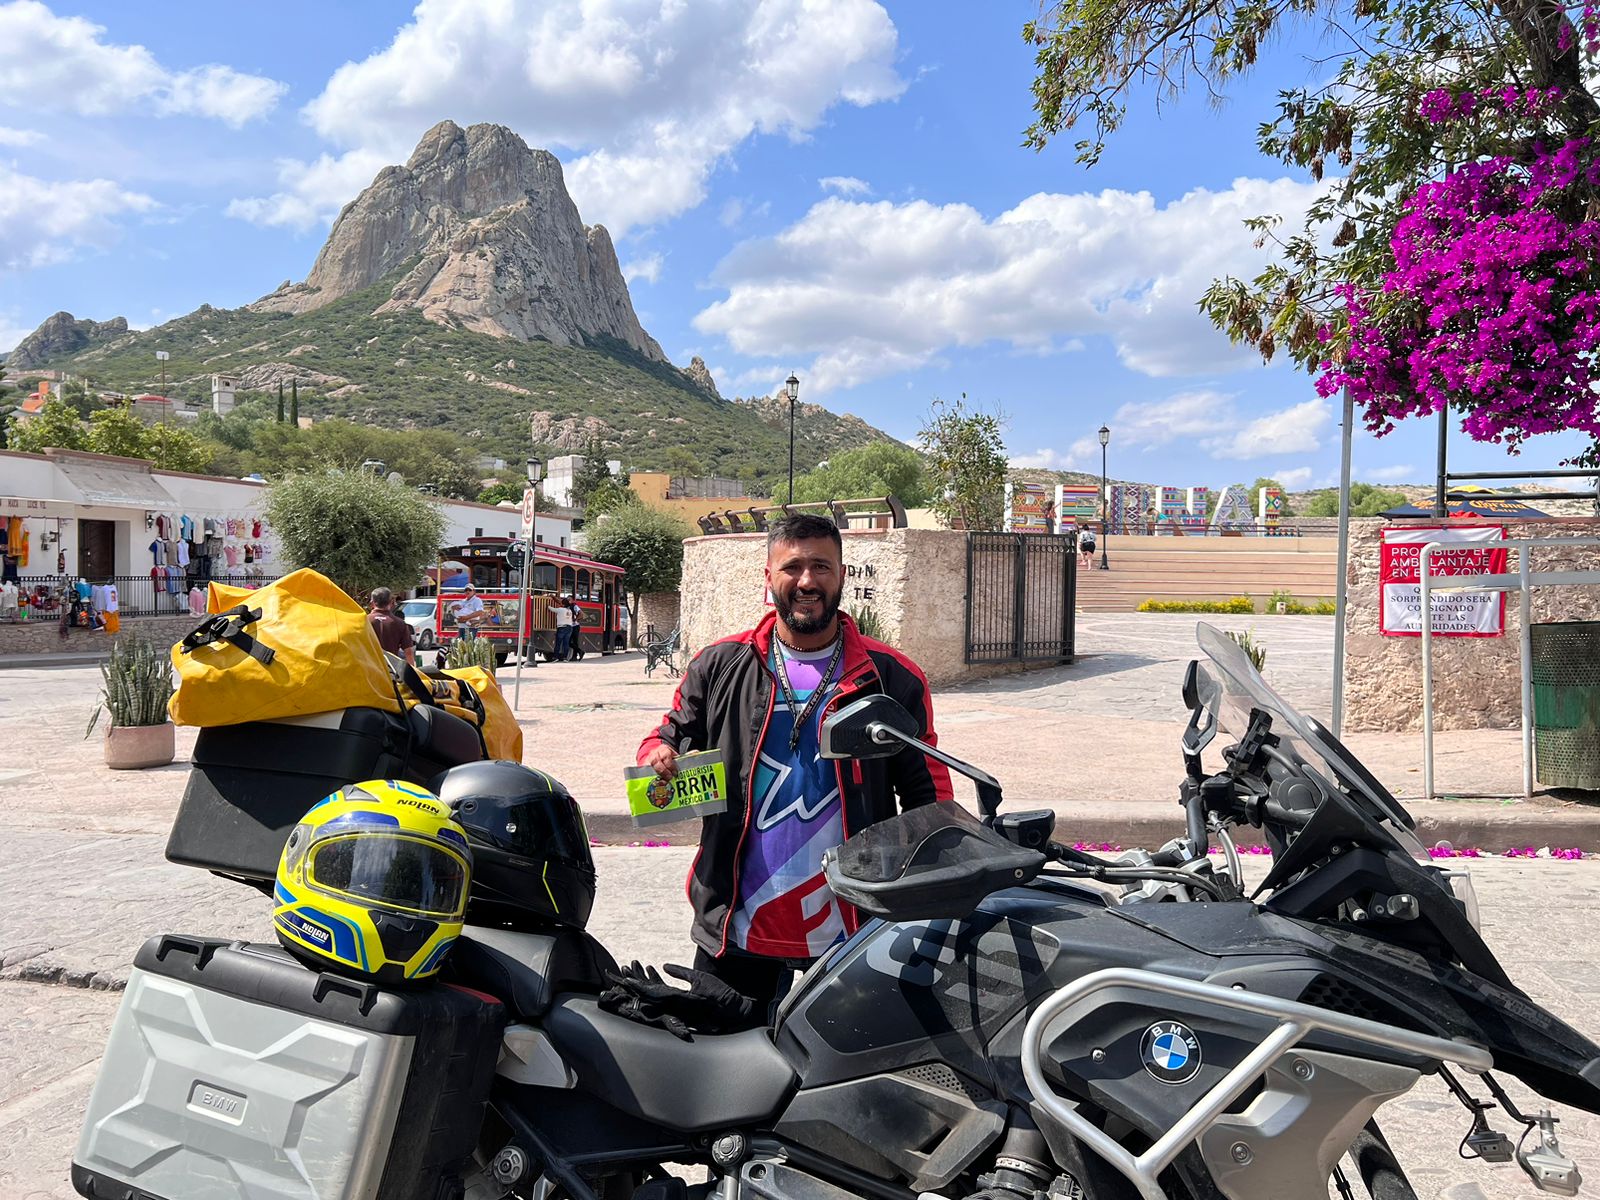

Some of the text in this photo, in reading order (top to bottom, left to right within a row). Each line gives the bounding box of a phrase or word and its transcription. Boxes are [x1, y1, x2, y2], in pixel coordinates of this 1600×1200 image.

[1391, 547, 1469, 556] PROIBIDO
[1390, 557, 1490, 567] AMBLANTAJE
[847, 564, 875, 578] DIN
[1392, 567, 1491, 577] EN ETA ZONA
[1391, 595, 1463, 604] SORPRNDIDO
[1407, 604, 1474, 612] COSIGNADO
[1448, 613, 1466, 622] LAS
[1405, 623, 1476, 631] AUTRIDADES
[676, 773, 717, 798] RRM
[679, 795, 703, 806] MEXICO
[397, 799, 440, 815] NOLAN
[301, 922, 330, 941] NOLAN
[1151, 1024, 1197, 1049] BMW
[203, 1091, 238, 1113] BMW
